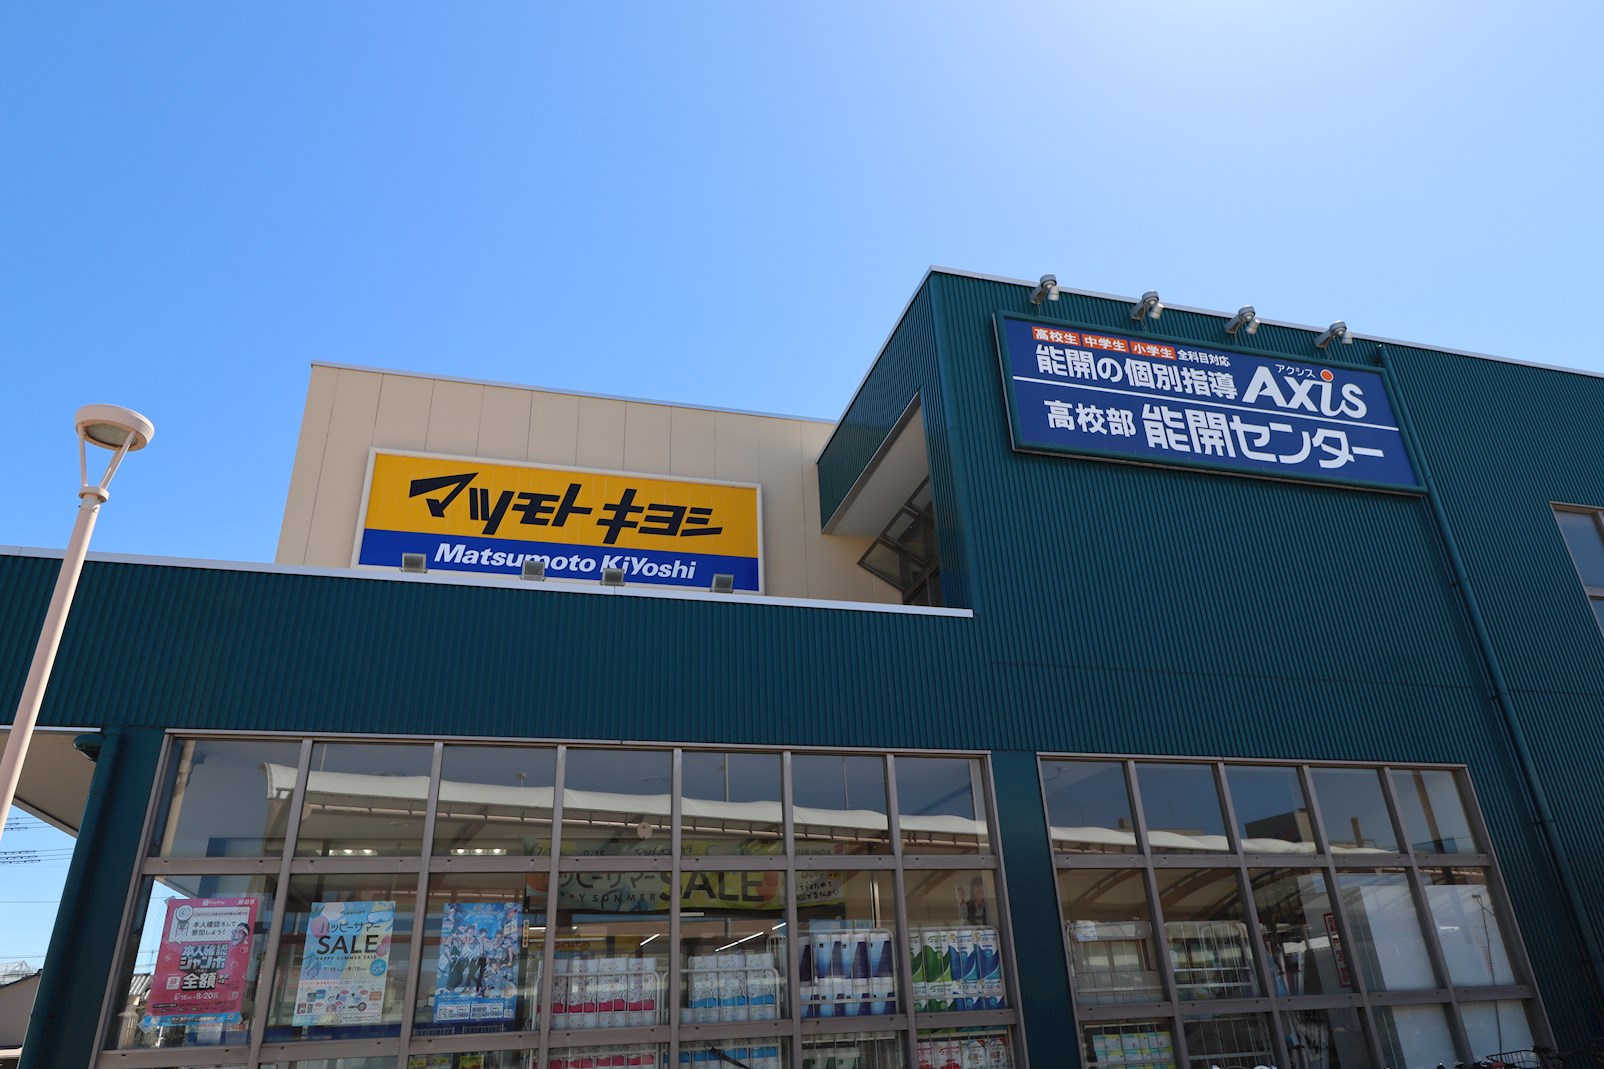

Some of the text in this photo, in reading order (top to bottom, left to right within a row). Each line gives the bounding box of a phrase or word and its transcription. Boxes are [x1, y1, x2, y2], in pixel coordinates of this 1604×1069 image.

[1034, 327, 1231, 368] 高校生 中学生 小学生 全科目対応
[1035, 343, 1238, 401] 能開の個別指導
[1275, 363, 1316, 379] アクシス
[1043, 400, 1385, 470] 高校部 能開センター
[408, 471, 724, 545] マツモトキヨシ
[434, 543, 697, 580] Matsumoto KiYoshi
[592, 892, 656, 902] SUMMER
[193, 920, 237, 928] 本人確認をして
[320, 921, 381, 933] ハッピーサマー
[182, 944, 229, 955] 本人確認
[316, 934, 379, 955] SALE
[179, 956, 226, 969] ジャンボ
[181, 972, 217, 989] 全額
